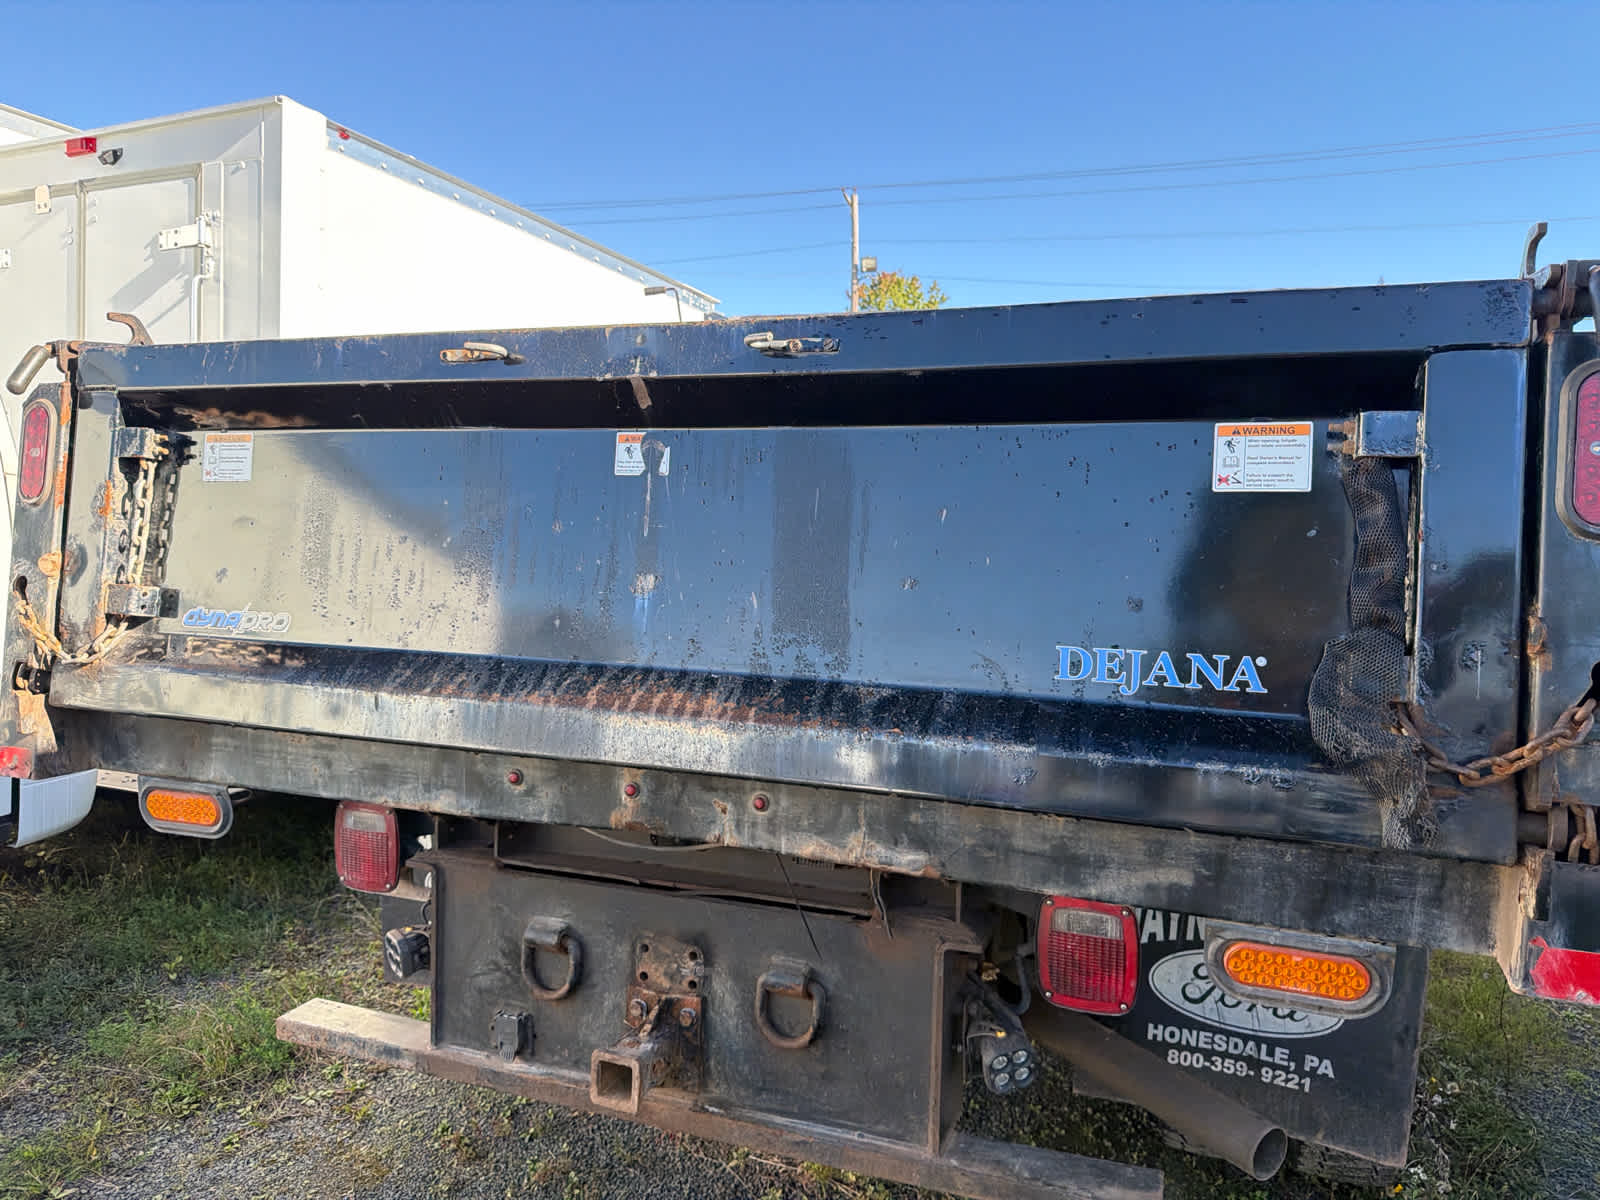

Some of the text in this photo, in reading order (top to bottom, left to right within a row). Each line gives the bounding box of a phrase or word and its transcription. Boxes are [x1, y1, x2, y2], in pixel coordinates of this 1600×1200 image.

[1242, 426, 1296, 435] WARNING
[1147, 1022, 1335, 1079] HONESDALE, PA
[1167, 1048, 1312, 1093] 800-359- 9221
